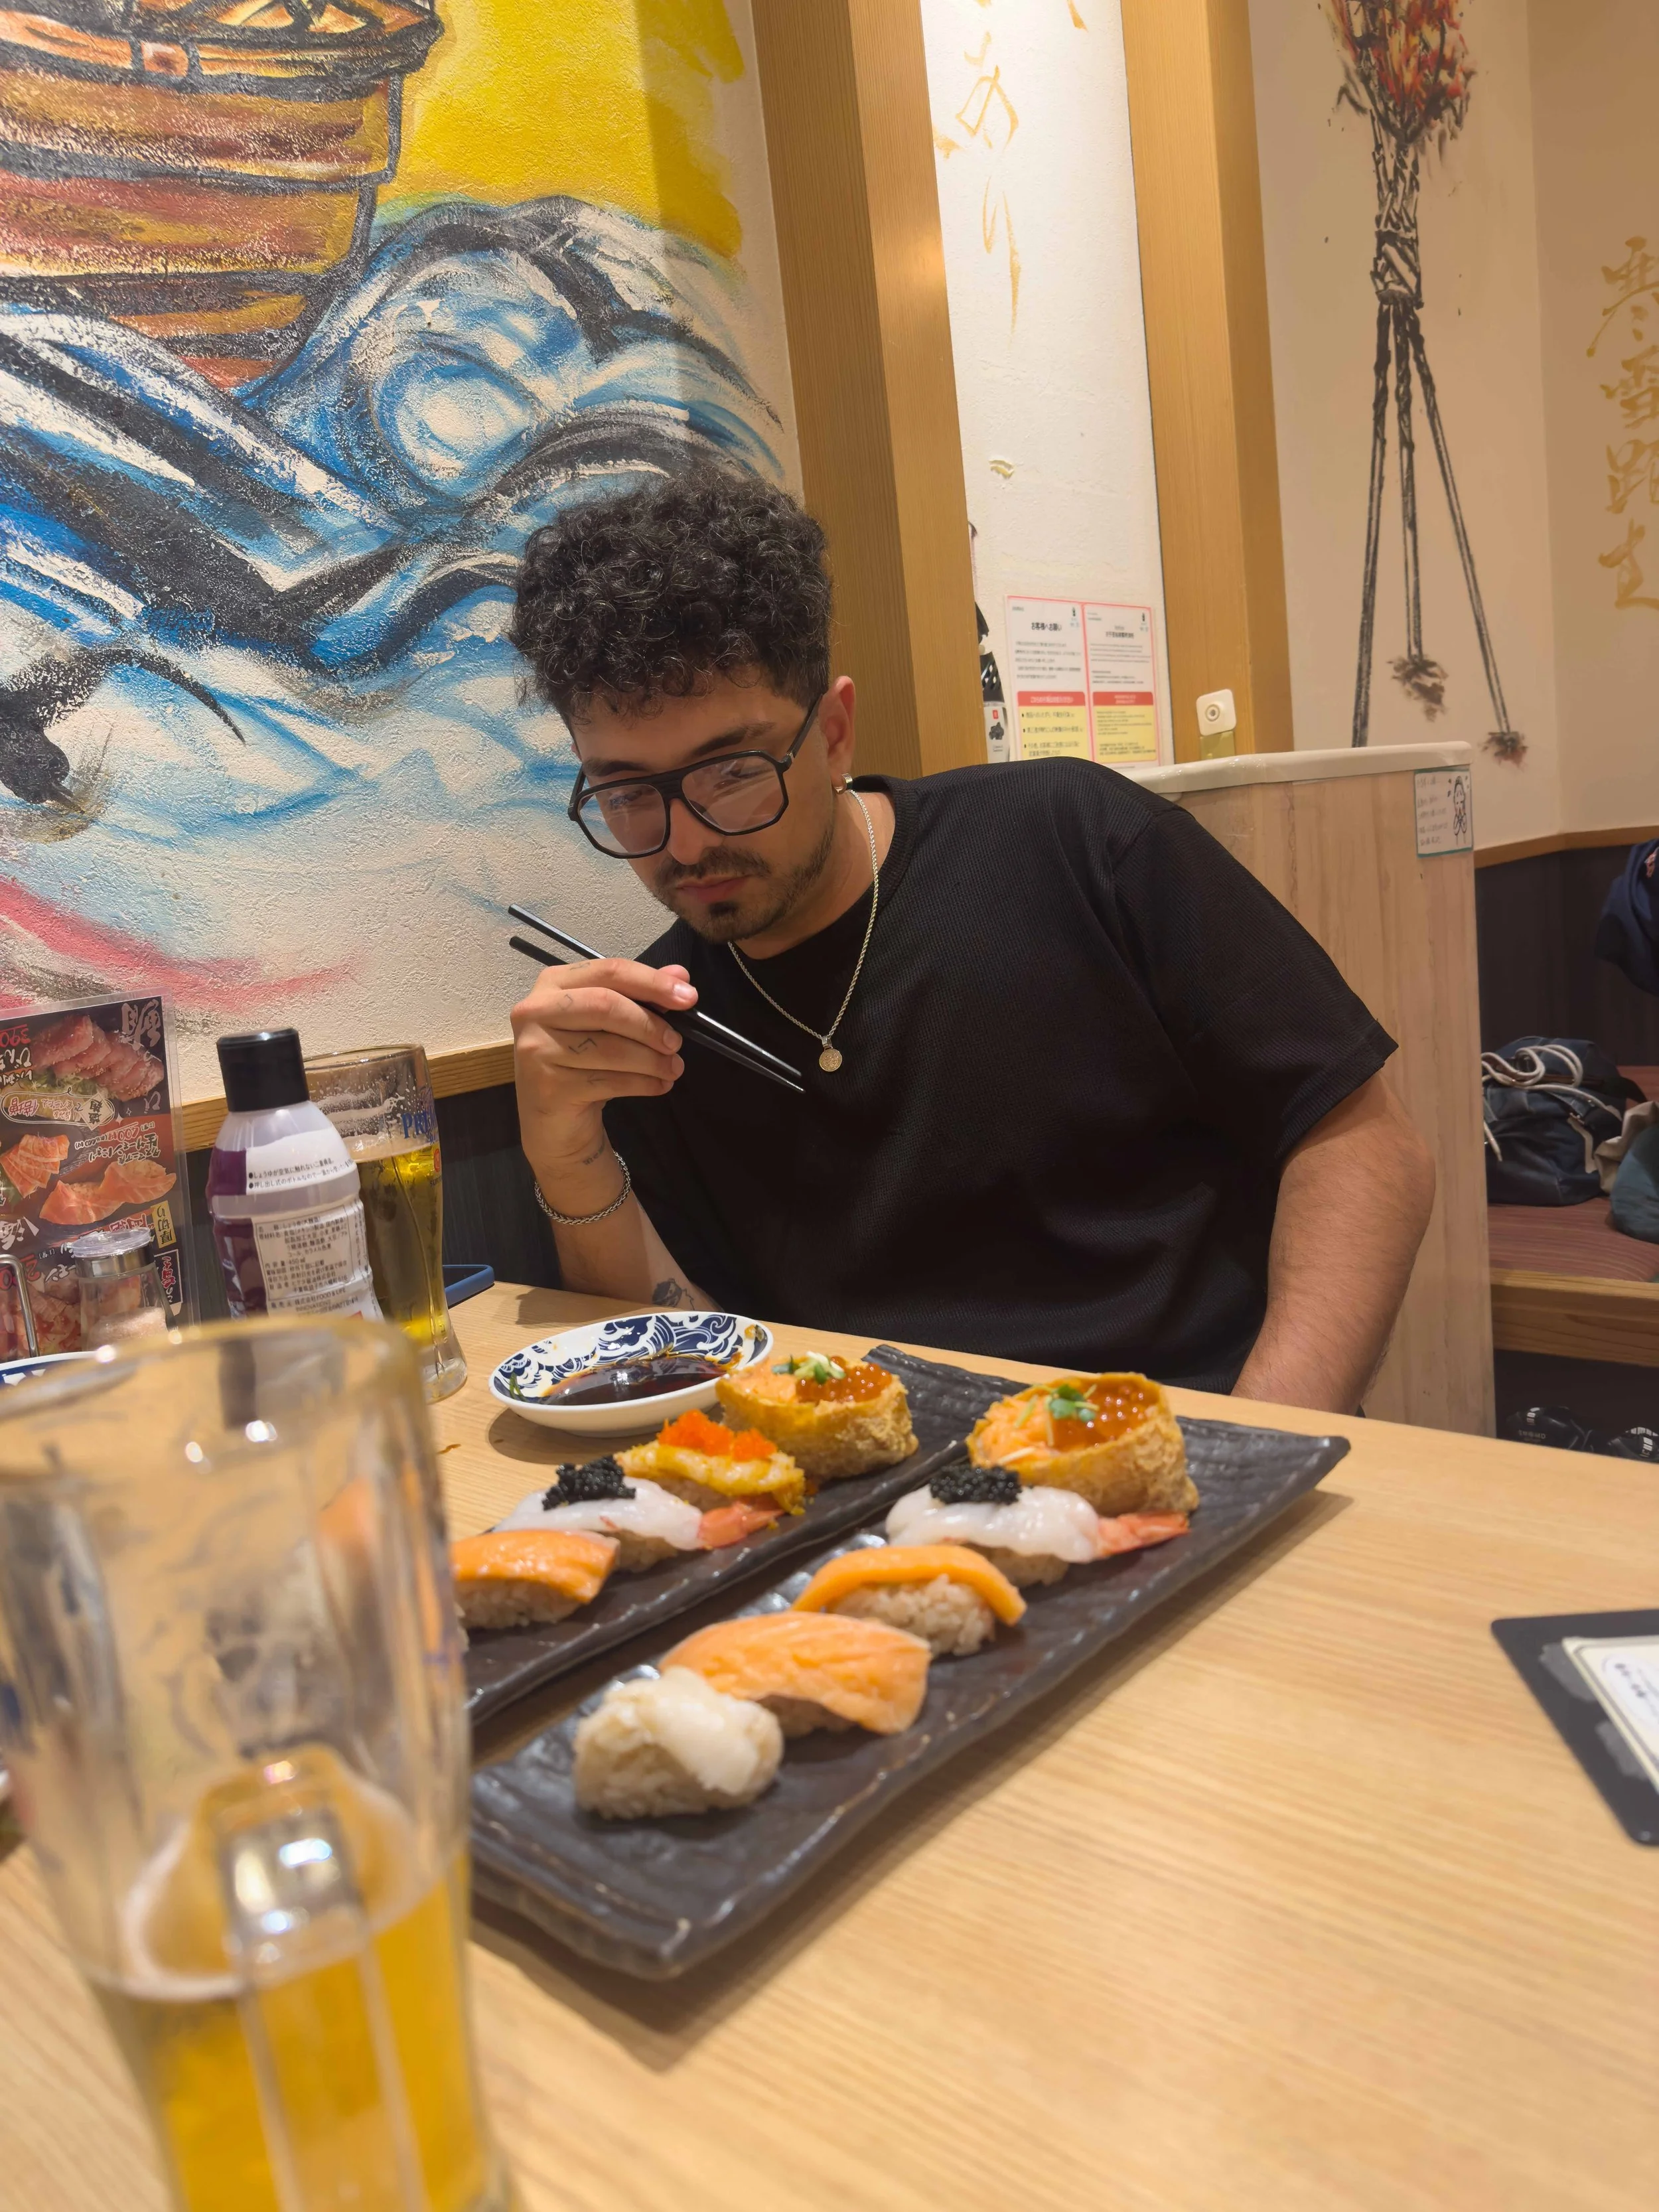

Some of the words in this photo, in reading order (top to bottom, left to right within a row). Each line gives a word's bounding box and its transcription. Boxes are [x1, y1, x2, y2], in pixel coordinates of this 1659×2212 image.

[117, 1149, 162, 1165] タスマニア産
[157, 1205, 173, 1245] 厚切り
[161, 1256, 177, 1303] この旨さ
